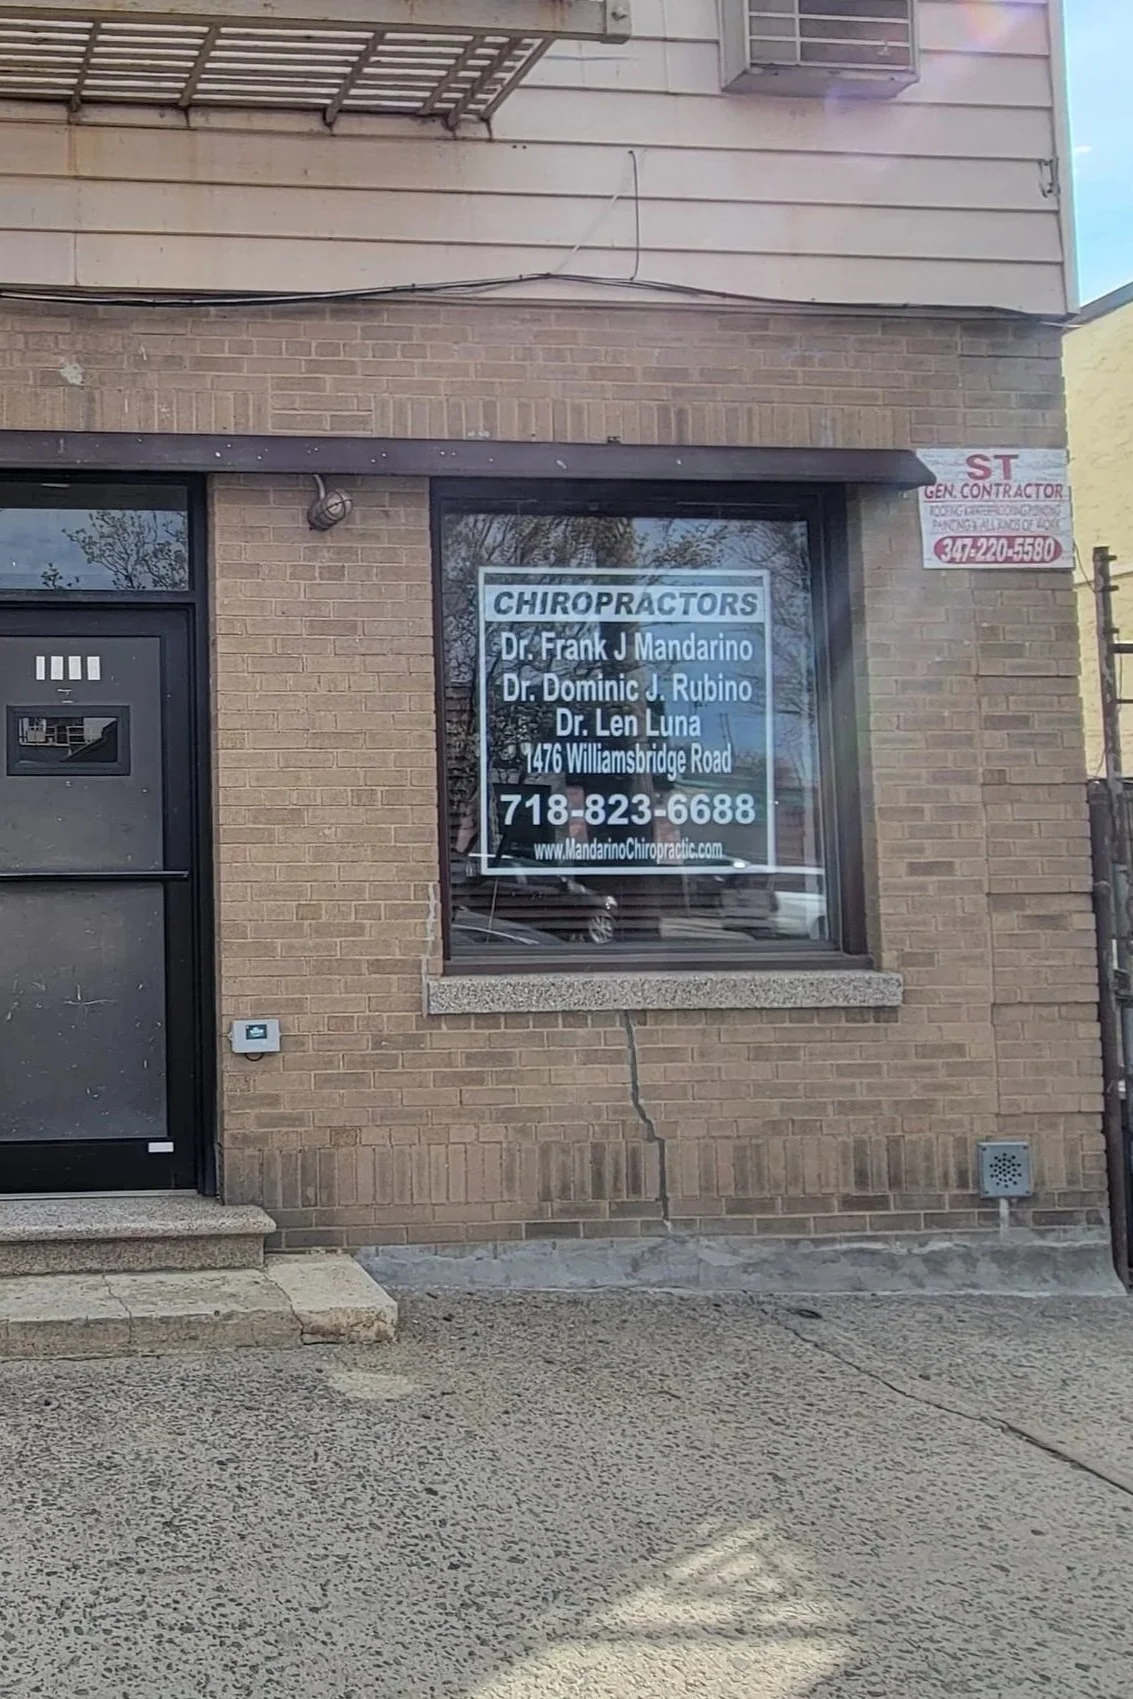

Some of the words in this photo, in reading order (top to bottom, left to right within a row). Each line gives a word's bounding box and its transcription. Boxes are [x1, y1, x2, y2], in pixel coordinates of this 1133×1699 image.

[966, 453, 1019, 481] ST
[924, 483, 957, 499] GEN.
[960, 483, 1063, 499] CONTRACTOR
[941, 537, 1055, 562] 347-220-5580
[493, 590, 759, 618] CHIROPRACTORS
[501, 632, 533, 661] Dr.
[541, 632, 608, 661] Frank
[614, 633, 626, 661] J
[634, 632, 754, 661] Mandarino
[503, 673, 535, 702] Dr.
[543, 673, 639, 702] Dominic
[646, 673, 665, 702] J.
[672, 672, 753, 702] Rubino
[556, 708, 588, 737] Dr.
[596, 708, 638, 737] Len
[645, 708, 701, 737] Luna
[525, 742, 562, 774] 1476
[566, 742, 686, 782] Williamsbridge
[691, 742, 732, 774] Road
[499, 792, 756, 826] 718-823-6688
[534, 836, 723, 865] www.MandarinoChiropractic.com
